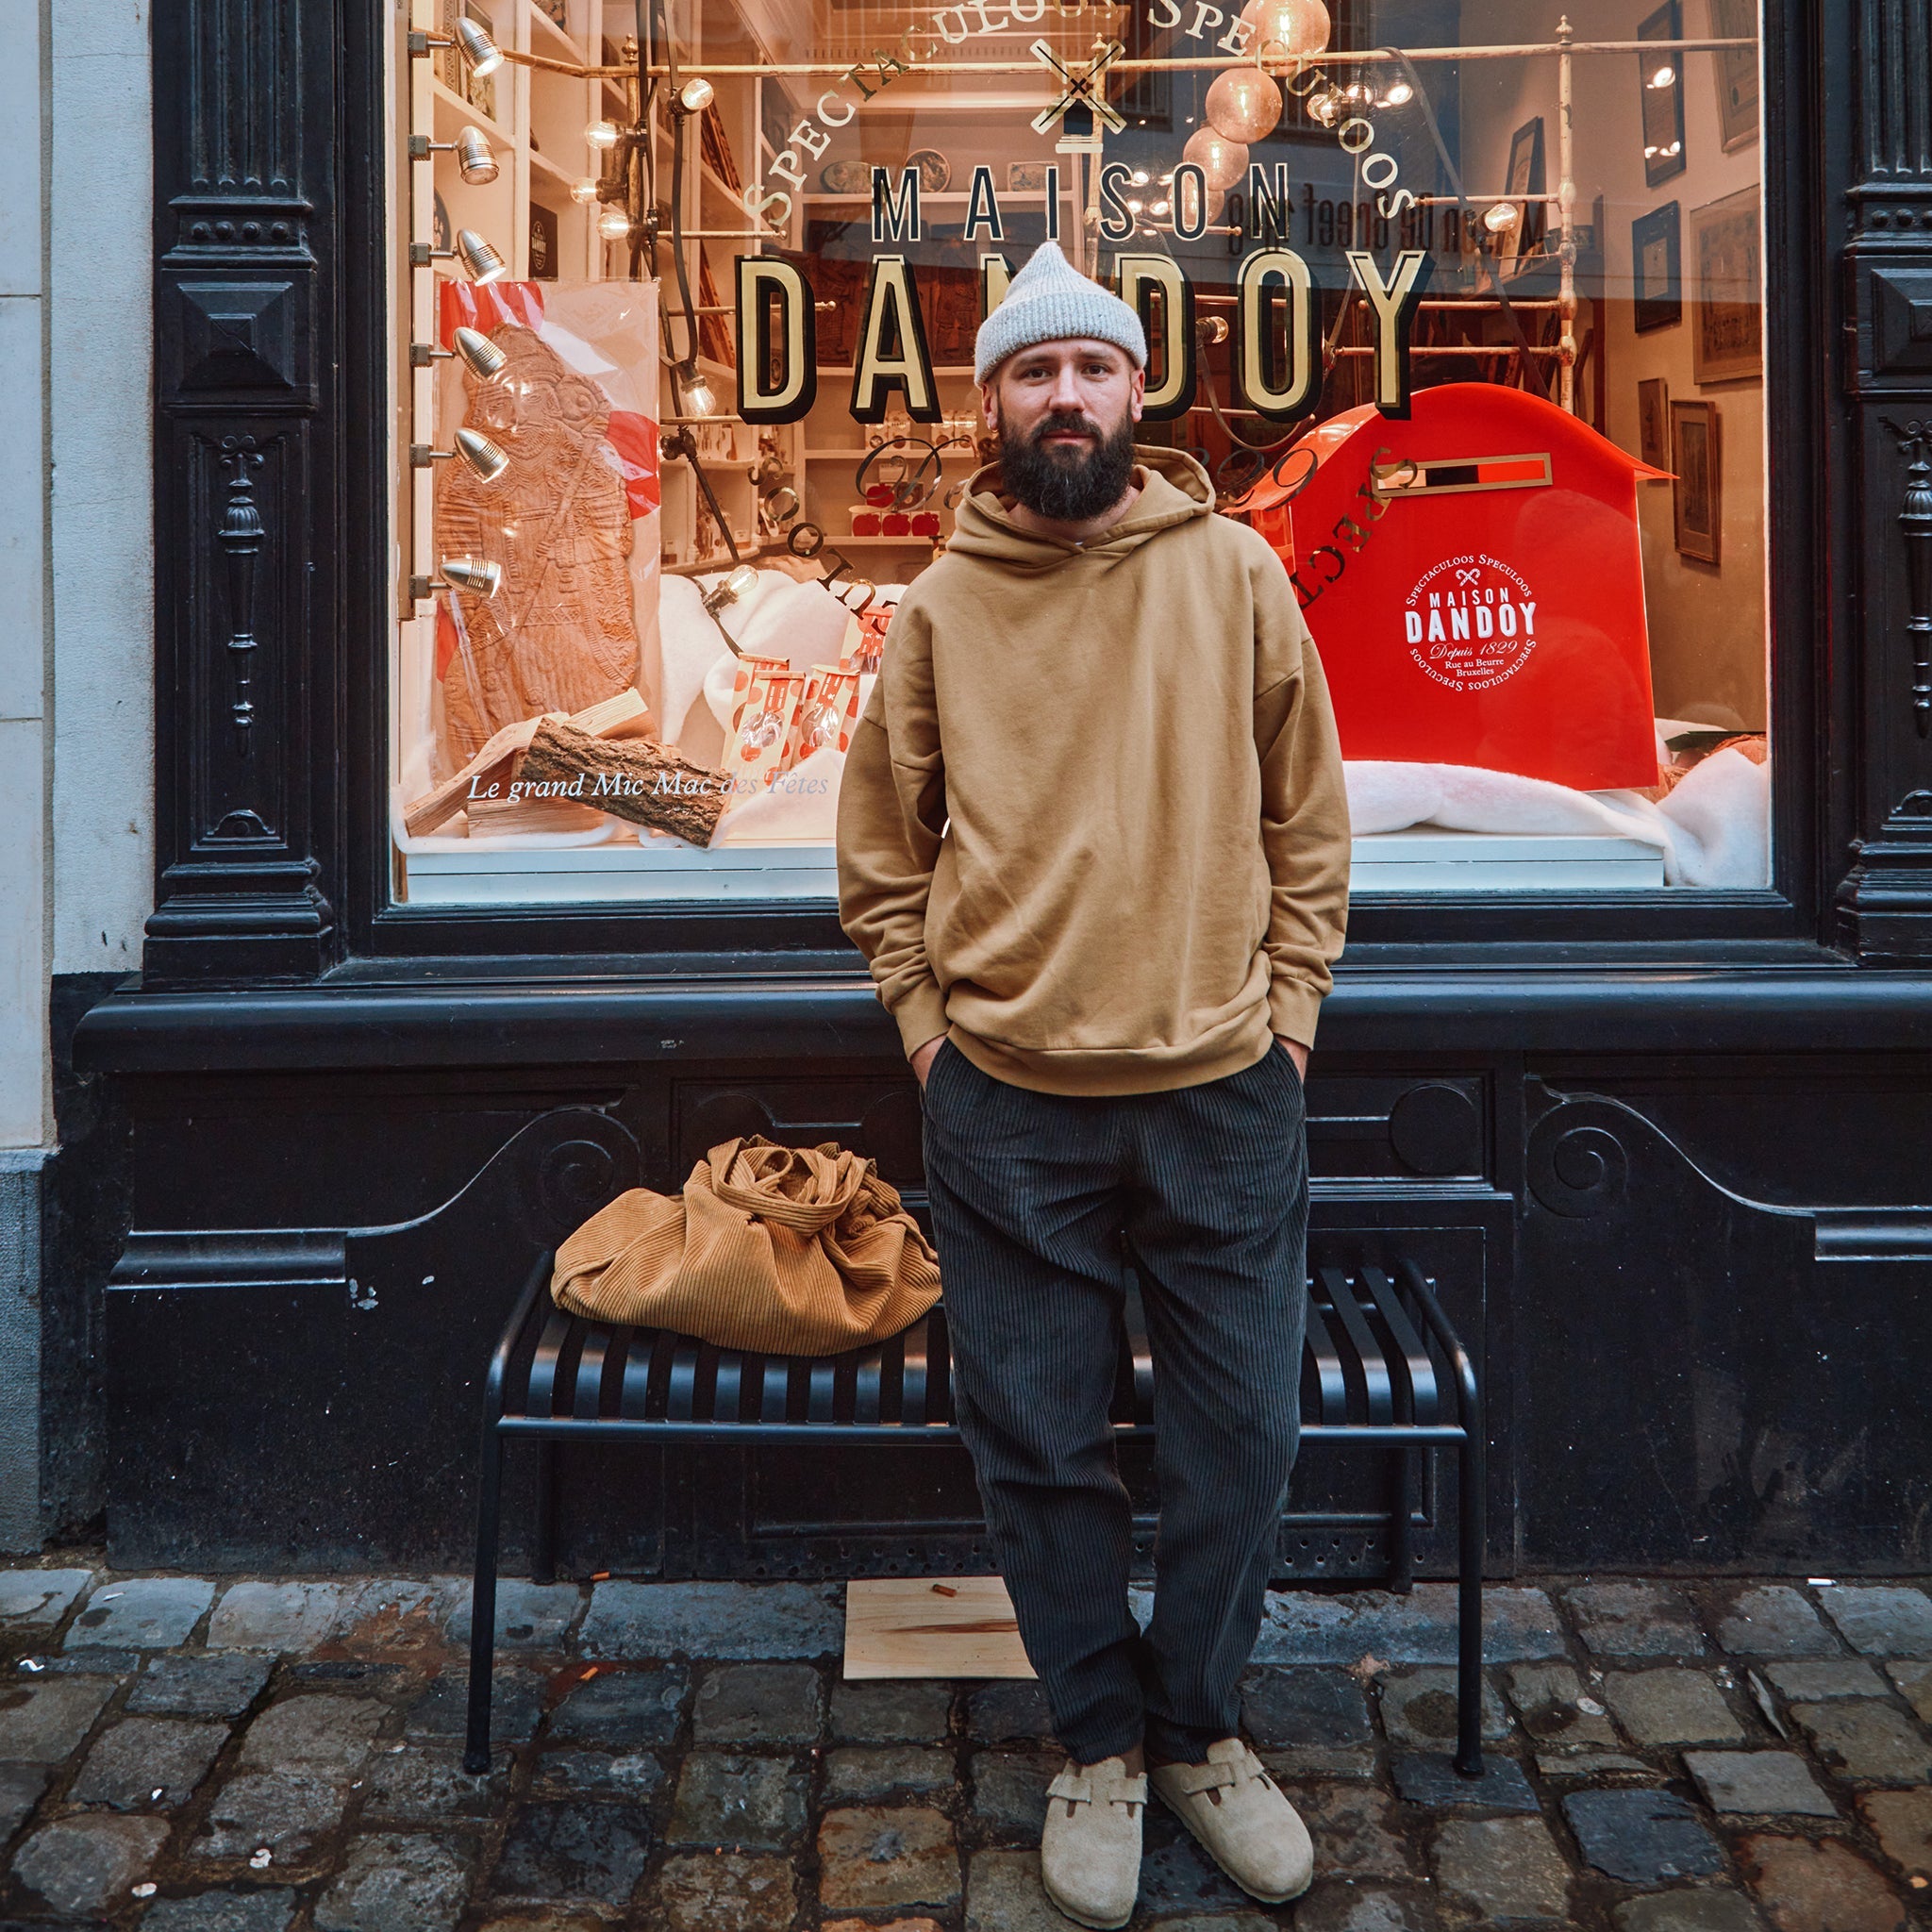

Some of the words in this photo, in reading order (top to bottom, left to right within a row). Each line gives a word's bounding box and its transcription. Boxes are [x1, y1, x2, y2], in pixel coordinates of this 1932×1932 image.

[871, 161, 1289, 242] MAISON
[734, 247, 1436, 425] DADOY
[1406, 555, 1474, 607] SPECTACULOOS
[1478, 554, 1532, 597] SPECULOOS
[1429, 587, 1509, 608] MAISON
[1405, 602, 1537, 644] DANDOY
[1409, 648, 1464, 691] SPECULOOS
[1429, 642, 1474, 660] Depuis
[1479, 641, 1518, 656] 1829
[1444, 660, 1461, 670] Rue
[1475, 658, 1505, 667] Beurre
[1468, 639, 1537, 691] SPECTACULOOS
[1456, 668, 1494, 677] Bruxelles
[467, 774, 499, 800] Le
[508, 773, 584, 804] grand
[591, 773, 643, 796] Mic
[652, 772, 712, 796] Mac
[719, 772, 758, 795] des
[764, 770, 829, 795] Fêtes
